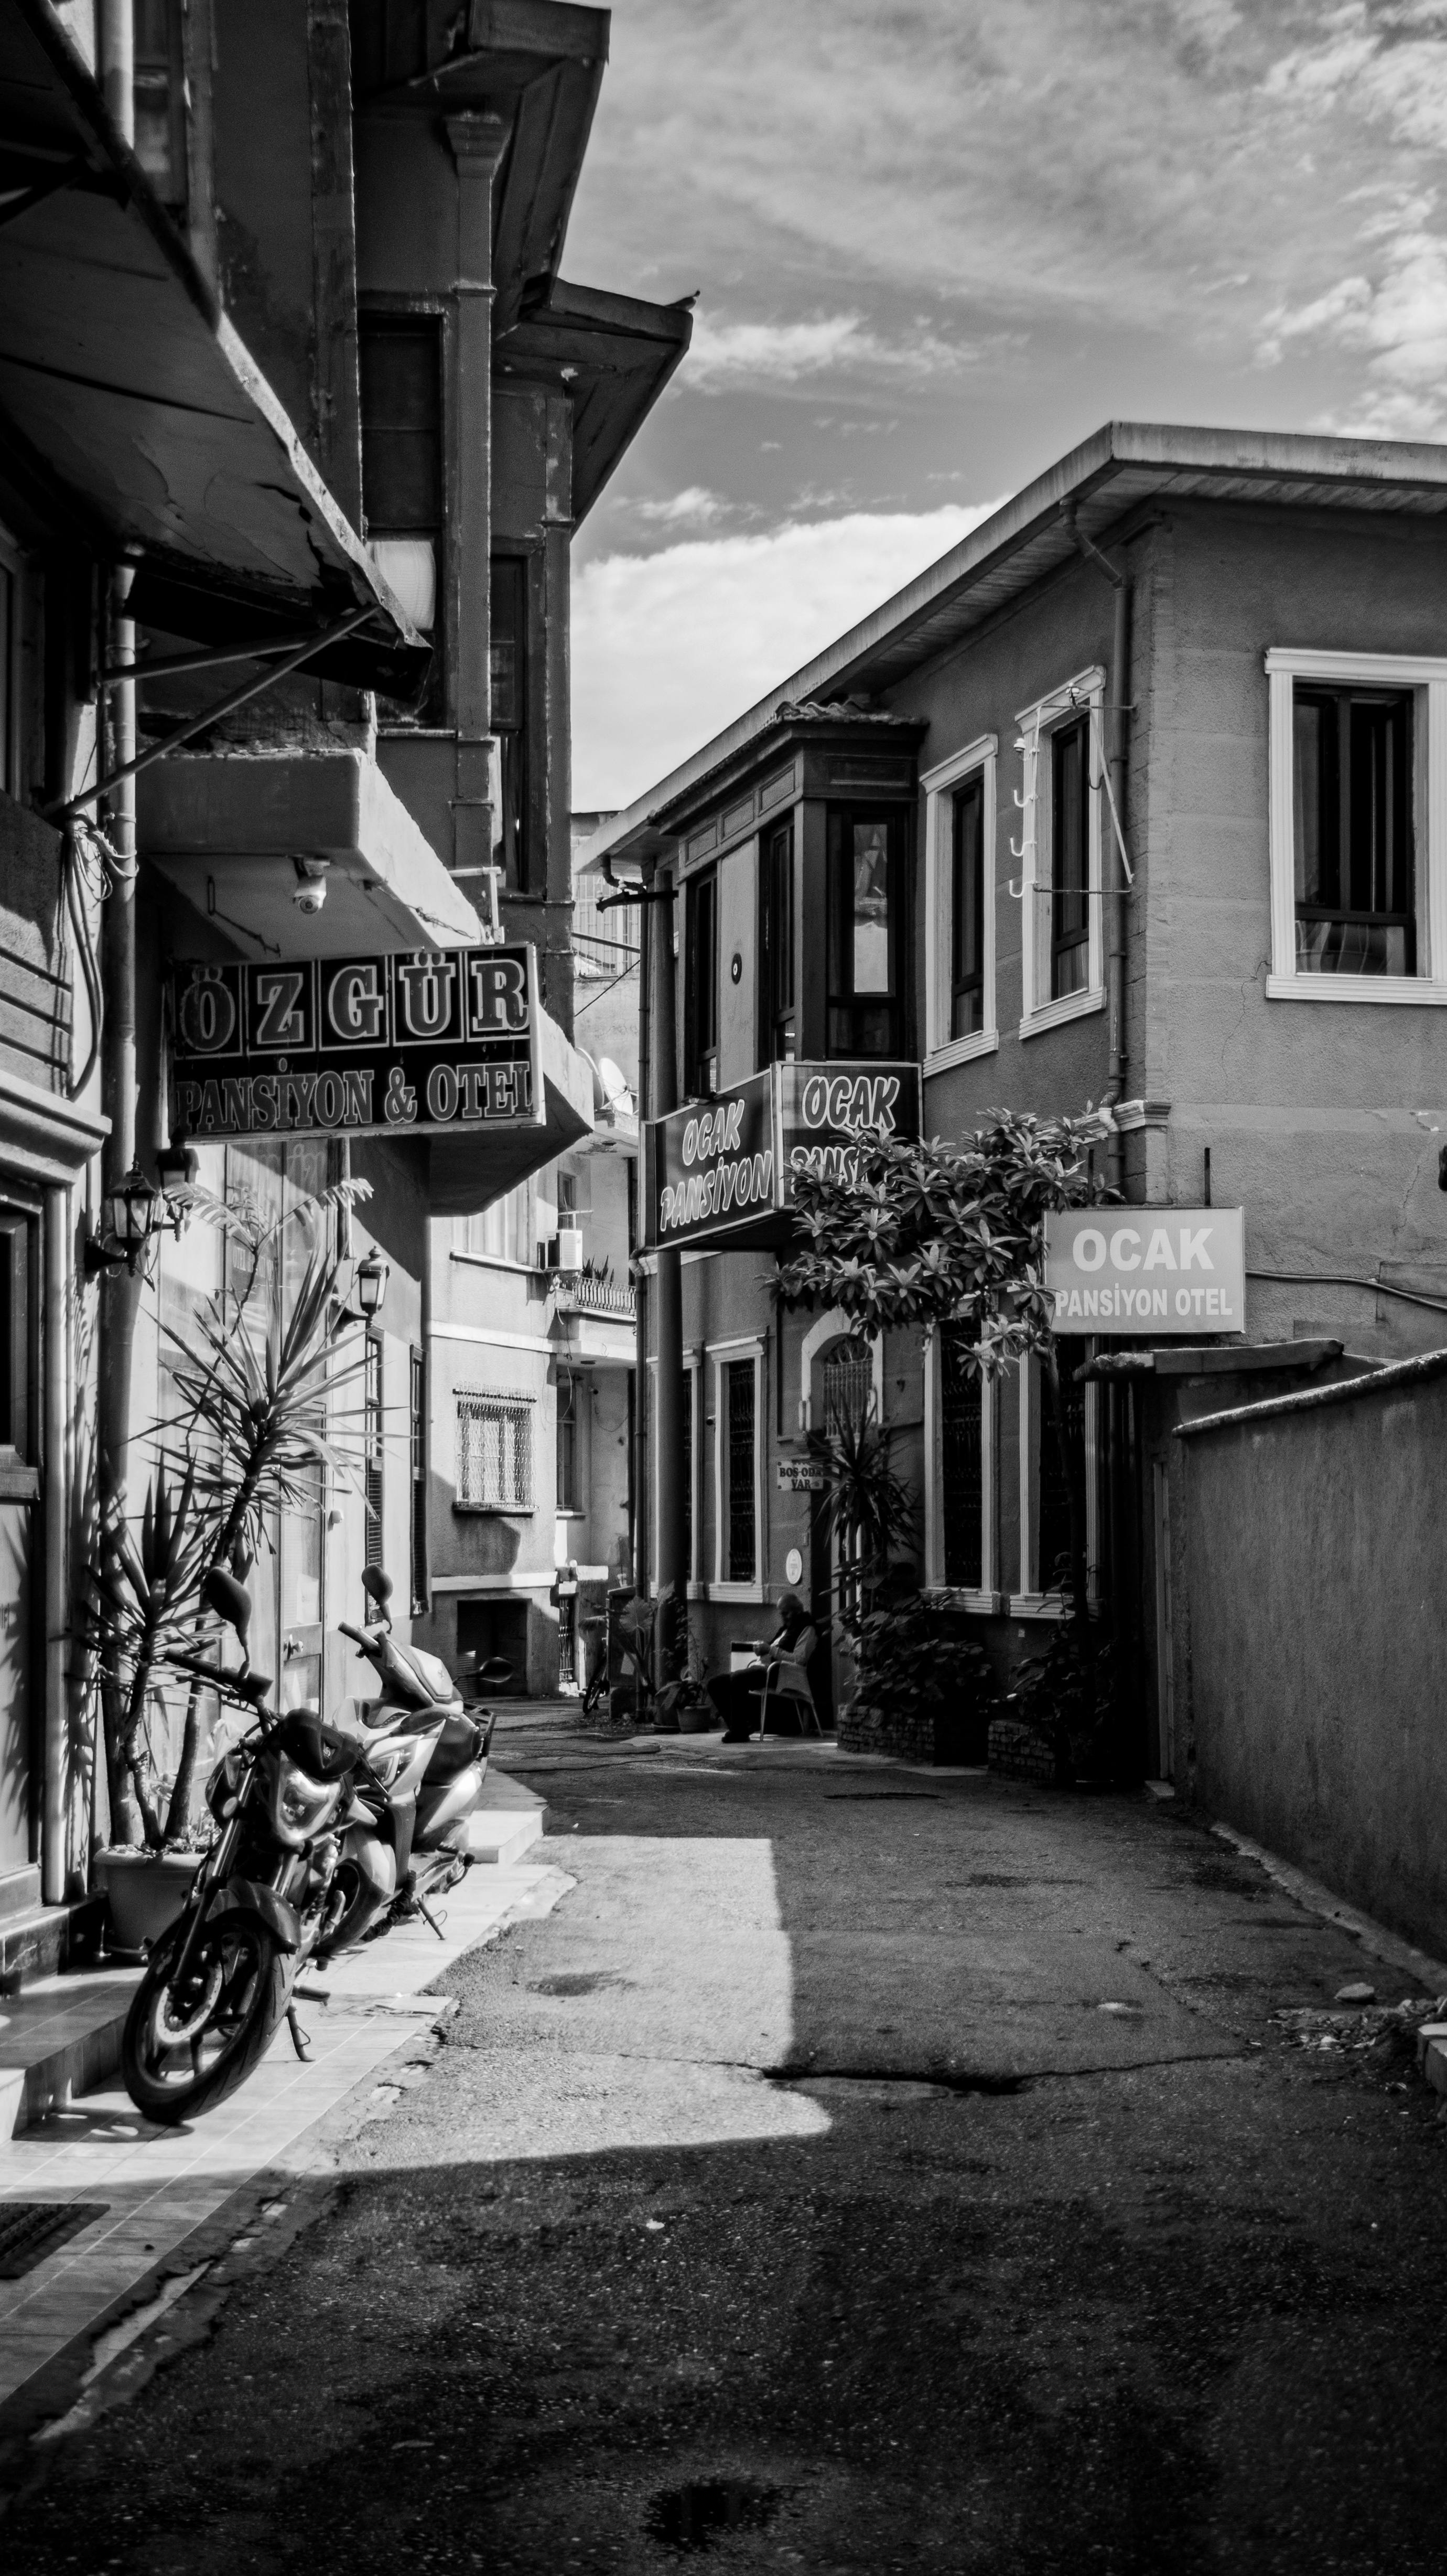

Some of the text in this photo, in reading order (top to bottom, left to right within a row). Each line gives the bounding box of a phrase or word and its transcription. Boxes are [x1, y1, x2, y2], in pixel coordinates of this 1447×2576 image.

[180, 952, 530, 1052] ÖZGÜR
[176, 1057, 535, 1134] PANSİYON & OTEL
[802, 1075, 901, 1133] OCAK
[683, 1099, 745, 1166] OCAK
[661, 1150, 772, 1232] PANSİYON
[1072, 1228, 1215, 1272] OCAK
[1055, 1283, 1233, 1317] PANSİYON OTEL
[792, 1479, 812, 1489] VAR
